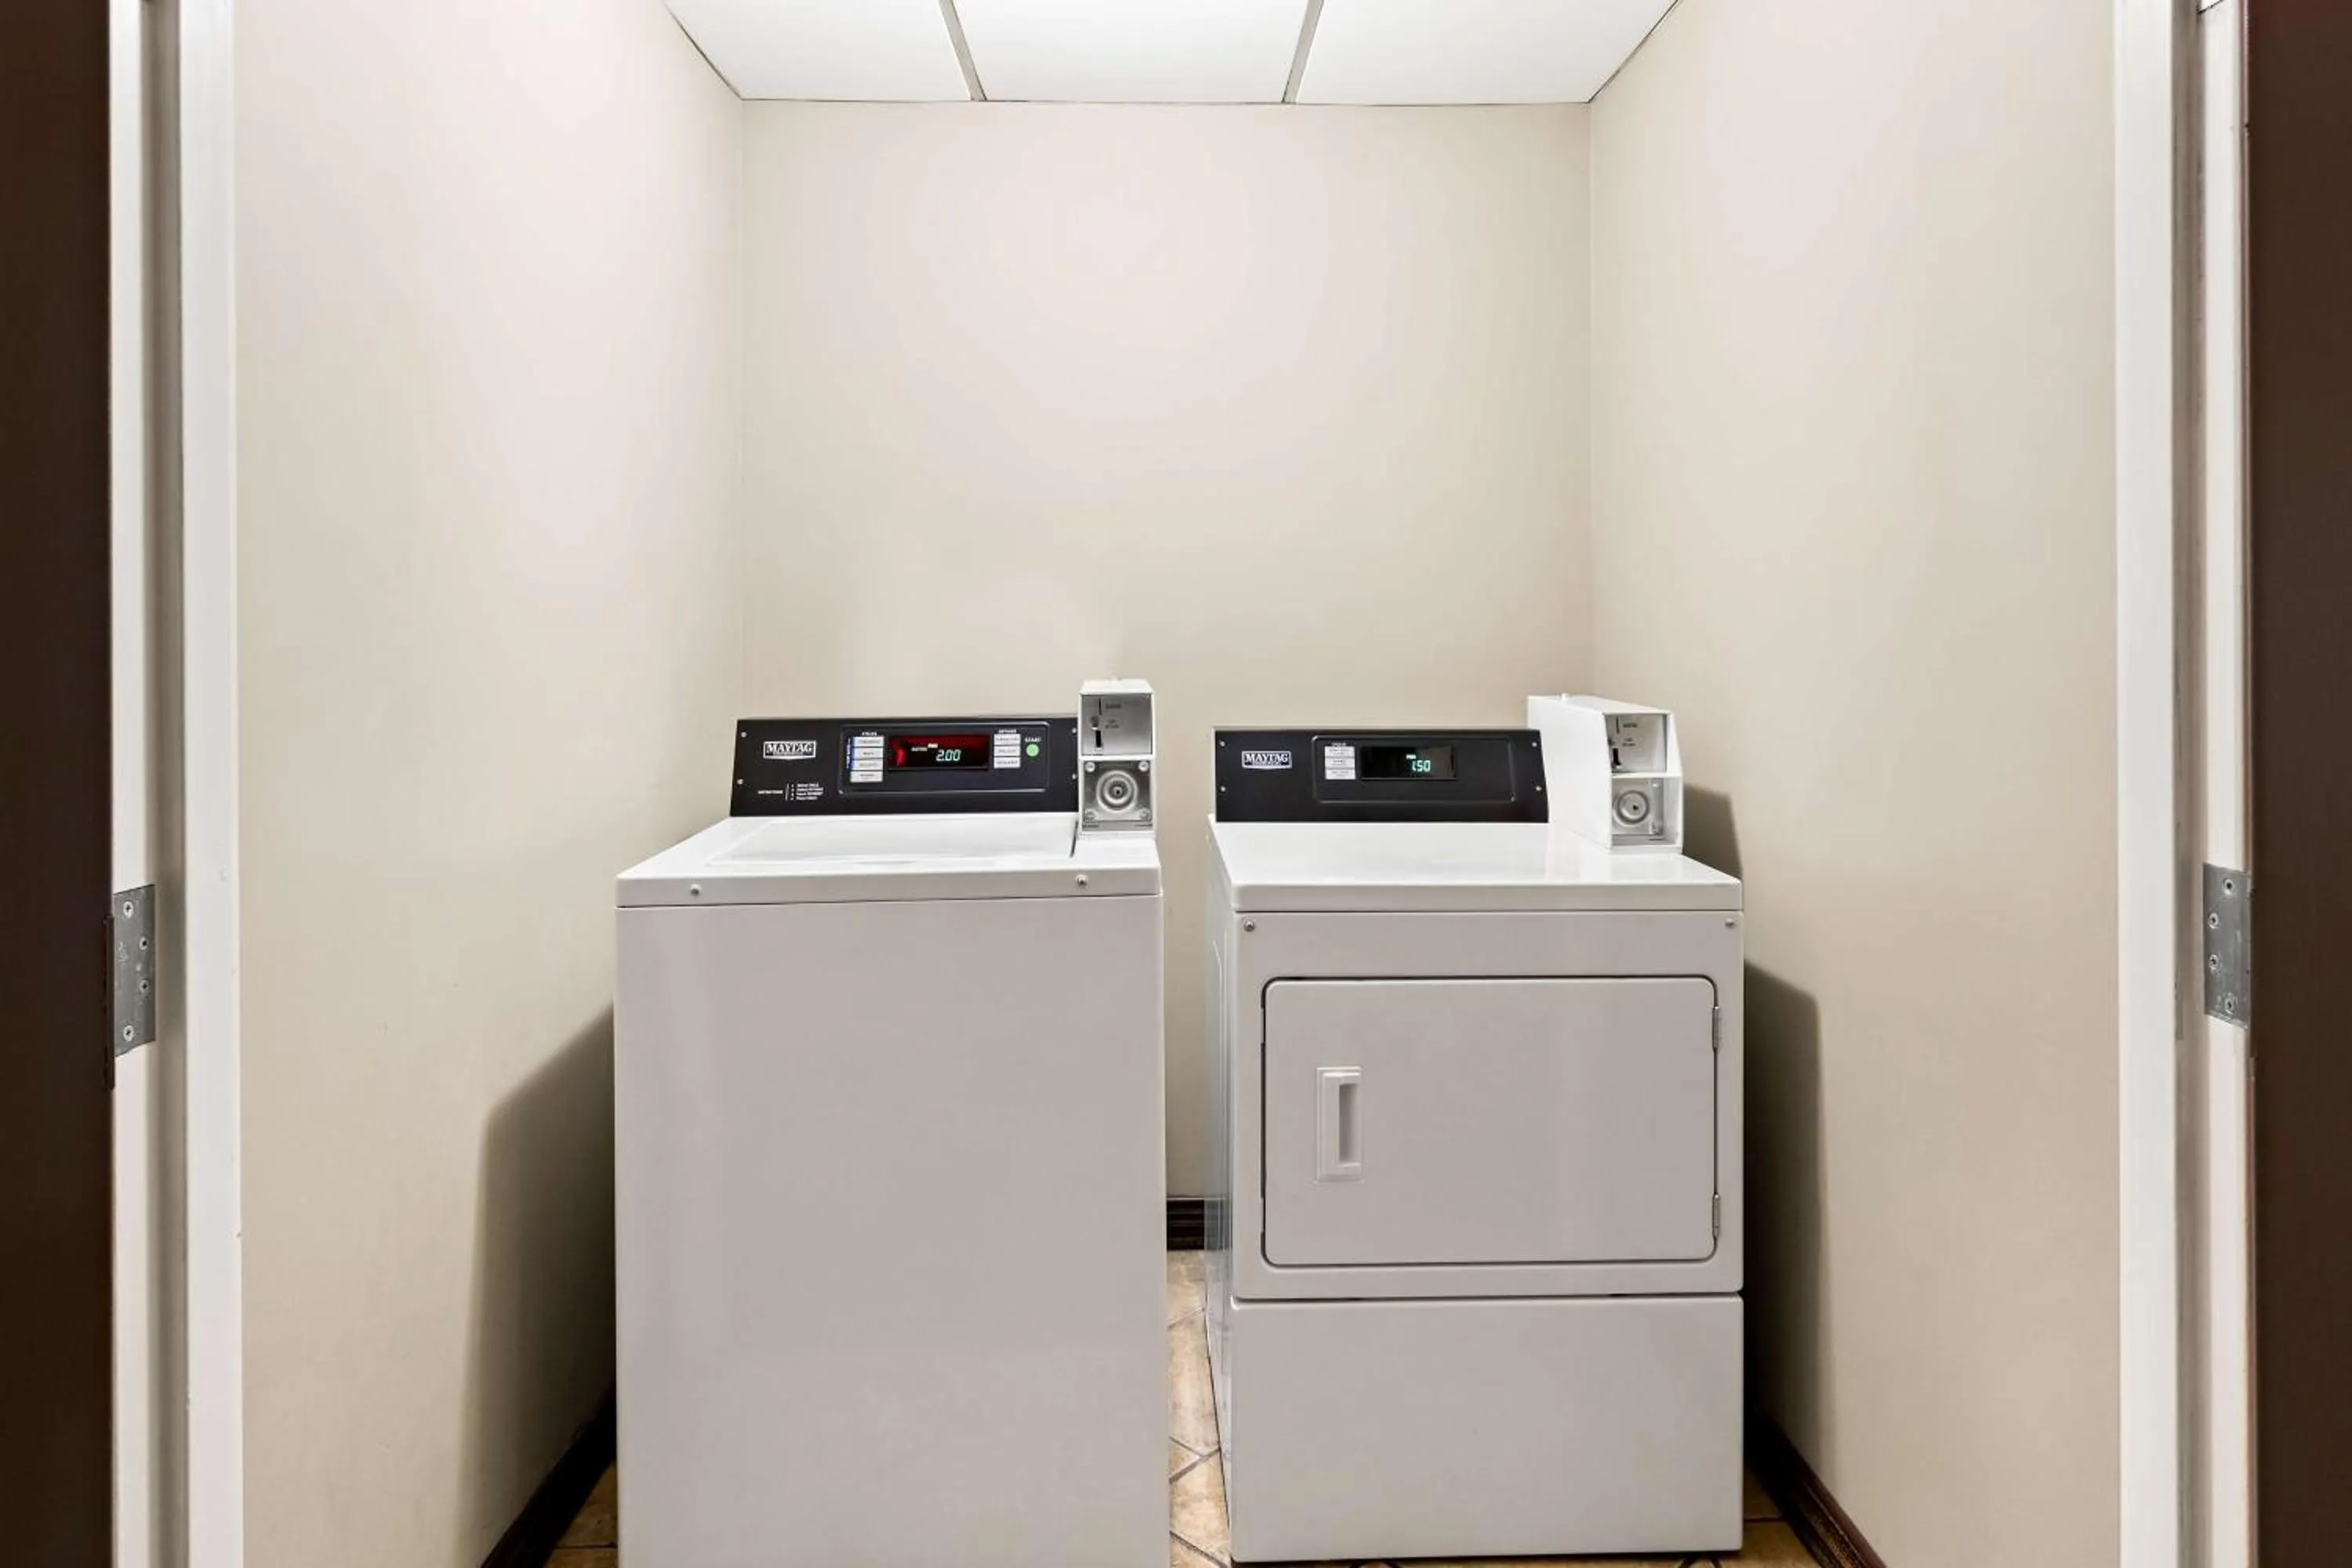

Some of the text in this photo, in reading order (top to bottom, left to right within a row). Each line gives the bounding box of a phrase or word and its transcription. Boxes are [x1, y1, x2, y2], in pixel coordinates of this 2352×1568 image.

[766, 742, 813, 753] MAYTAG
[935, 749, 961, 762] 2.00
[1244, 753, 1288, 763] MAYTAG
